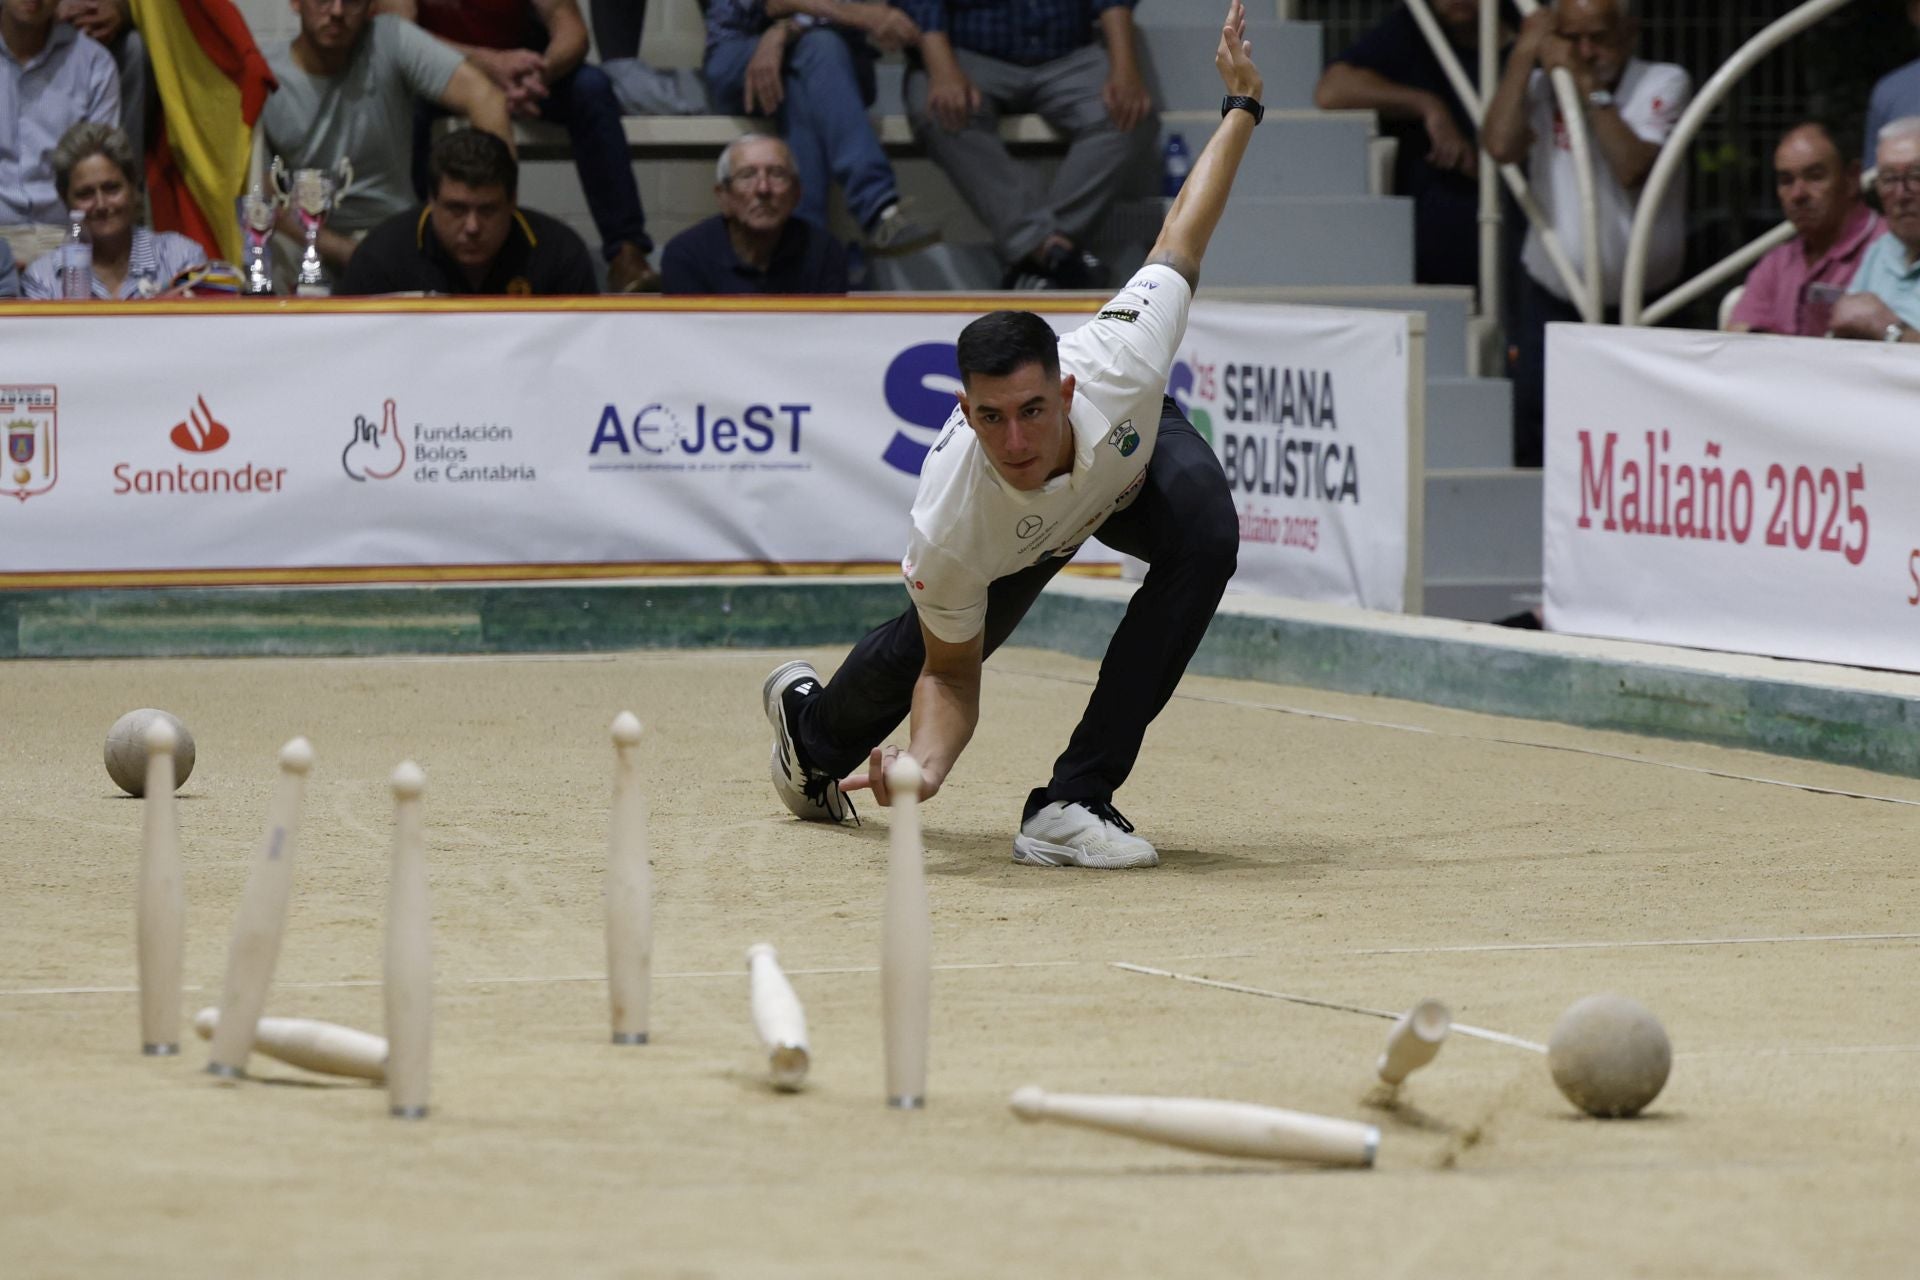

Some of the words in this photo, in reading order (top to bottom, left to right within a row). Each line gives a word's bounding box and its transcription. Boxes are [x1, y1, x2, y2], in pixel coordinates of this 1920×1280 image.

[1223, 363, 1337, 430] SEMANA
[414, 423, 513, 441] Fundación
[415, 444, 468, 461] Bolos
[1224, 429, 1360, 505] BOLÍSTICA
[113, 461, 287, 495] Santander
[414, 465, 439, 482] de
[445, 464, 536, 483] Cantabria
[1577, 429, 1754, 545] Maliaño
[1765, 462, 1868, 565] 2025
